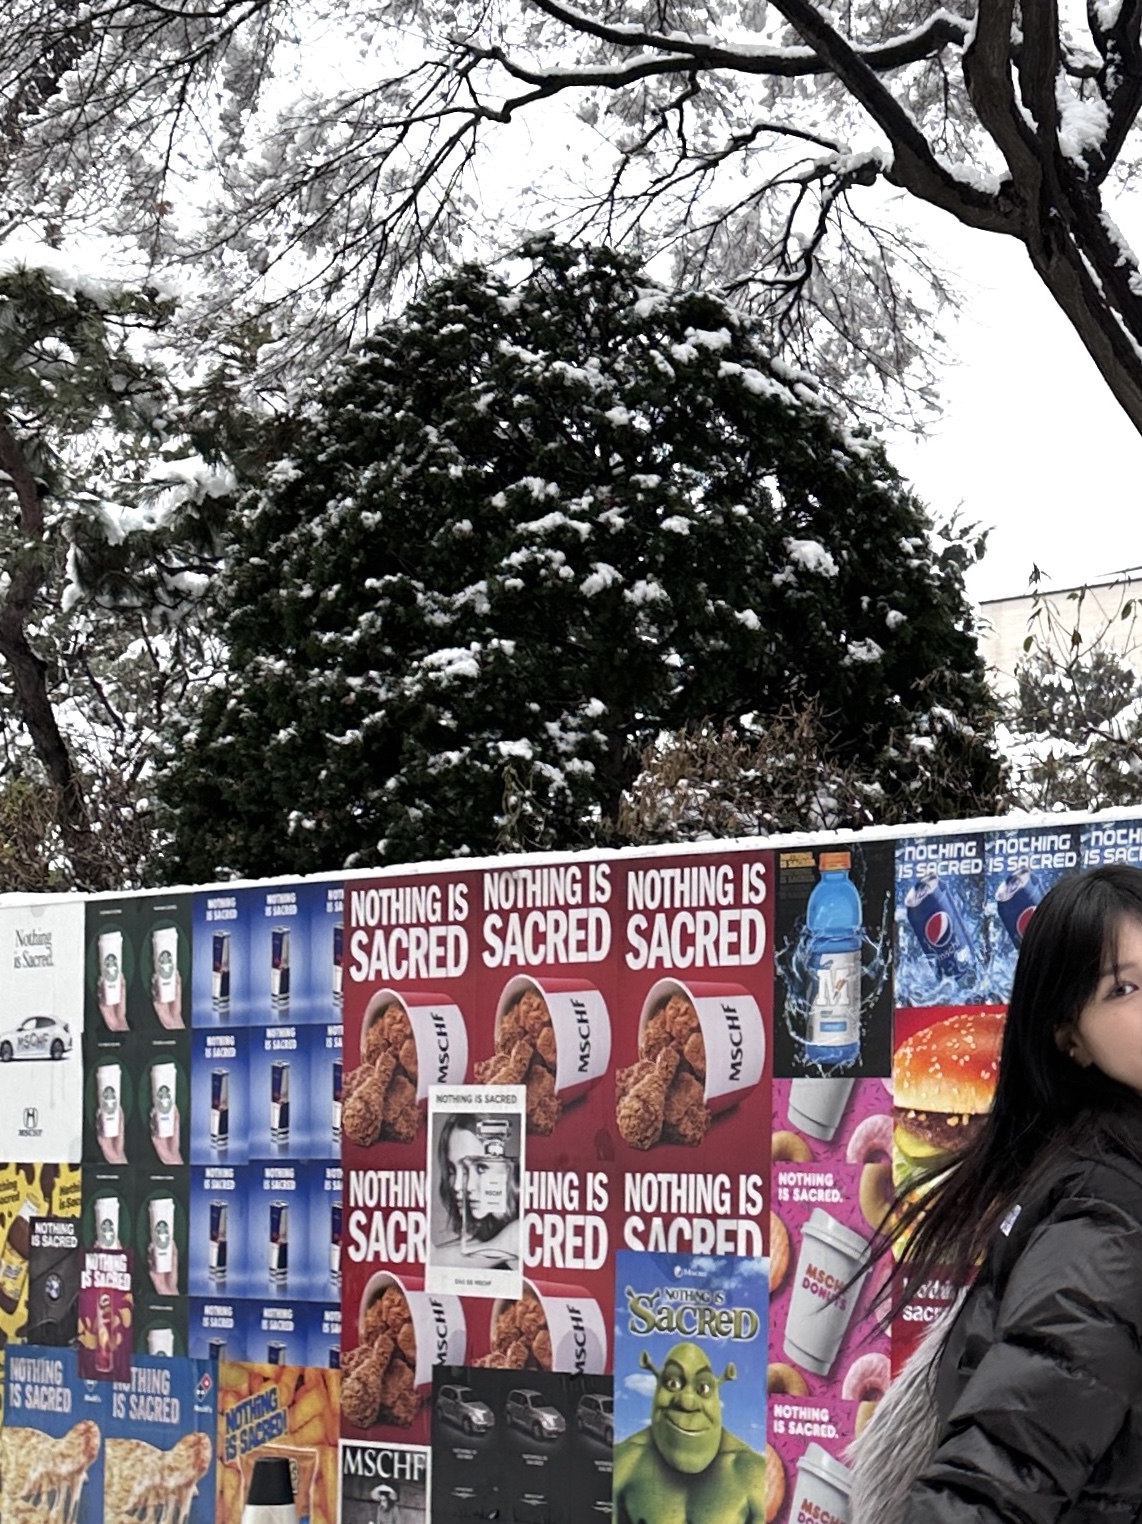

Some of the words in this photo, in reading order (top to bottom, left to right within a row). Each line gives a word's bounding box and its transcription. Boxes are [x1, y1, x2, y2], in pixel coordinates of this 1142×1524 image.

[904, 840, 977, 862] NOTHING
[995, 833, 1071, 856] NOTHING
[1084, 848, 1100, 865] IS
[898, 863, 914, 879] IS
[915, 858, 983, 878] SACRED
[988, 857, 1004, 874] IS
[1006, 852, 1077, 872] SACRED
[483, 866, 580, 911] NOTHING
[589, 863, 612, 905] IS
[627, 864, 733, 911] NOTHING
[743, 861, 767, 905] IS
[351, 885, 442, 928] NOTHING
[447, 882, 469, 922] IS
[15, 928, 52, 950] Nothing
[482, 906, 612, 968] SACRED
[625, 907, 767, 971] SACRED
[349, 924, 469, 983] SACRED
[431, 1012, 450, 1084] MSCHF
[570, 999, 588, 1073] MSCHF
[720, 1003, 744, 1082] MSCHF
[436, 1094, 473, 1105] NOTHING
[475, 1095, 483, 1104] IS
[484, 1094, 518, 1105] SACRED
[350, 1170, 428, 1208] NOTHIN
[586, 1172, 609, 1212] IS
[624, 1172, 731, 1215] NOTHING
[739, 1174, 764, 1216] IS
[778, 1172, 834, 1188] NOTHING
[778, 1186, 790, 1201] IS
[792, 1187, 843, 1203] SACRED.
[30, 1235, 40, 1247] IS
[41, 1235, 78, 1248] SACRED
[35, 1222, 75, 1235] NOTHING
[623, 1216, 764, 1257] SACRED
[85, 1253, 128, 1272] NOTHING
[81, 1271, 92, 1289] IS
[93, 1271, 132, 1292] SACRED
[664, 1288, 710, 1304] NOTHING
[711, 1290, 726, 1304] IS
[567, 1303, 587, 1381] MSCHF
[10, 1357, 64, 1386] NOTHING
[112, 1366, 171, 1396] THING
[10, 1384, 22, 1408] IS
[25, 1385, 72, 1413] SACRED
[112, 1392, 126, 1418] IS
[129, 1394, 181, 1424] SACRED
[225, 1386, 279, 1434] NOTHING
[773, 1404, 830, 1423] NOTHING
[773, 1419, 786, 1434] IS
[788, 1420, 840, 1440] SACRED.
[226, 1434, 238, 1463] IS
[343, 1447, 427, 1481] MSCHF
